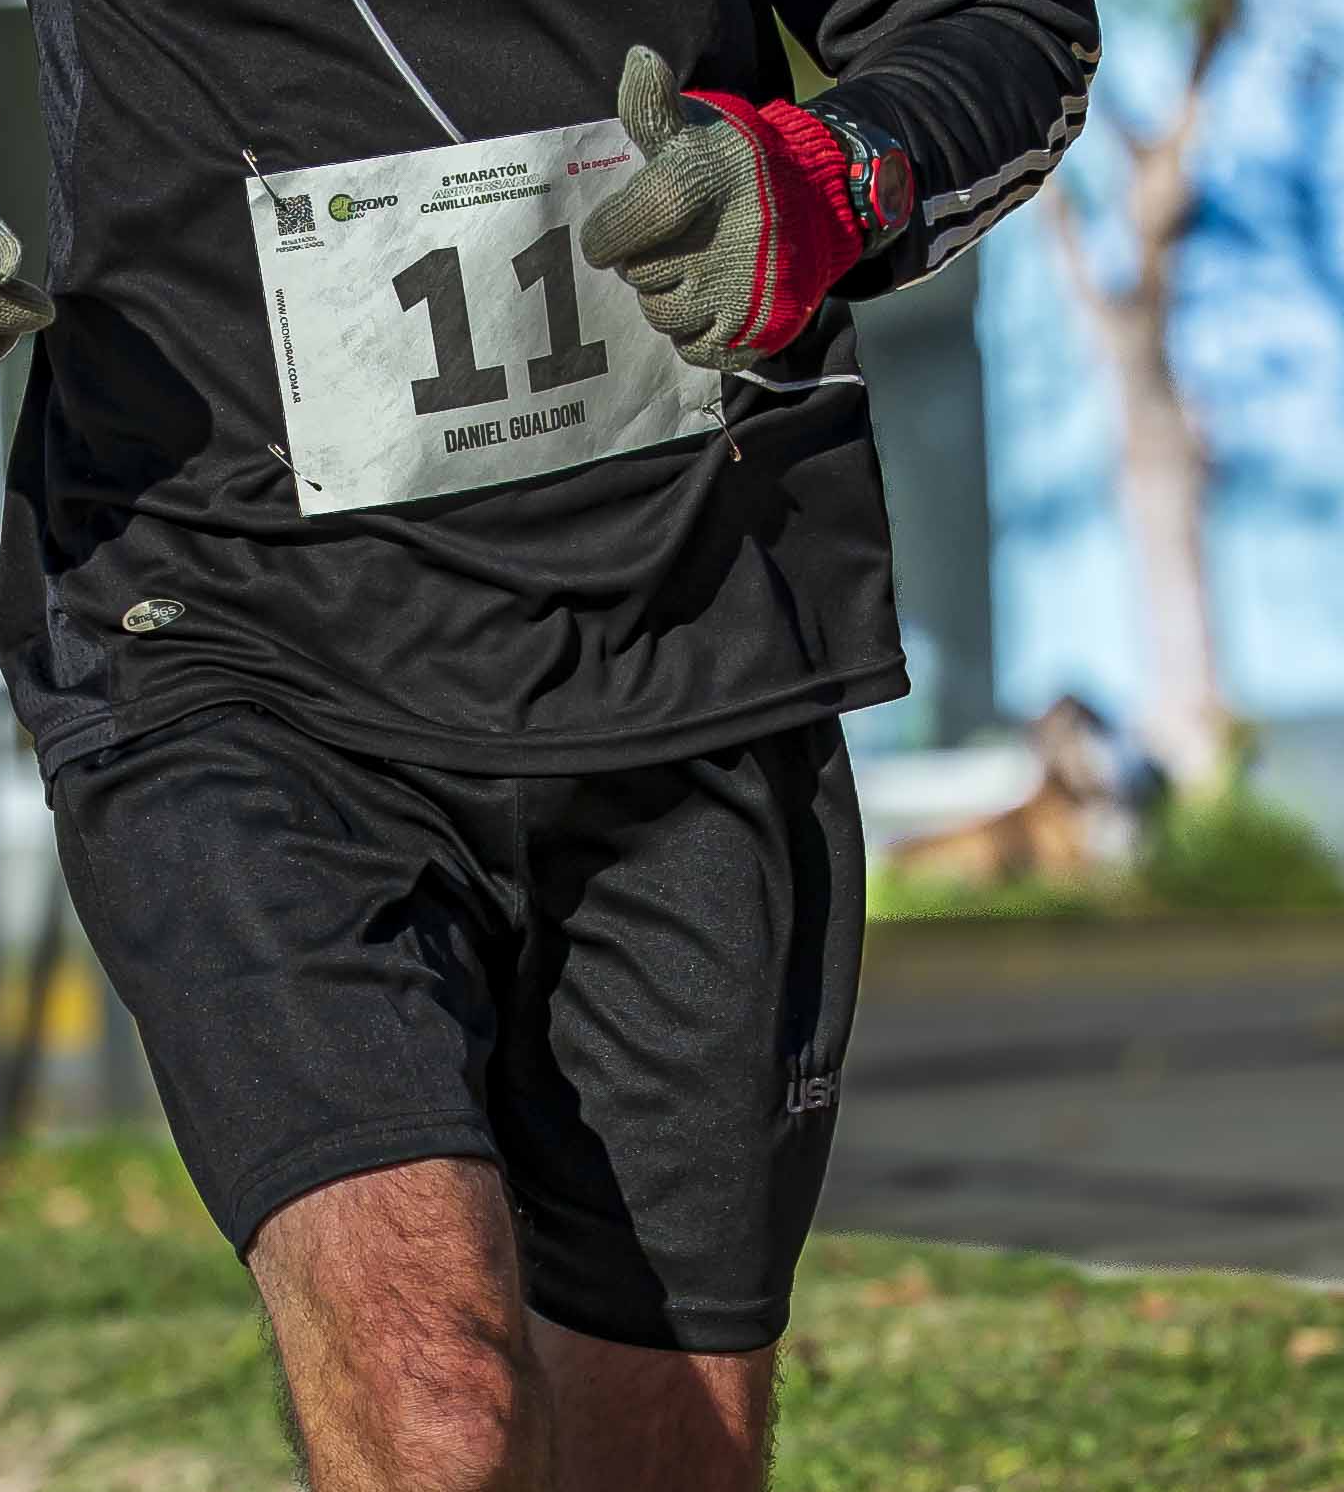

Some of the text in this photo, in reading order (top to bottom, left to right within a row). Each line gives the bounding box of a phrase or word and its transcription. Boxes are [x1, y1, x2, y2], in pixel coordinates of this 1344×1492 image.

[347, 194, 399, 212] CRONO
[275, 288, 302, 404] WWW.CRONORAV.COM.AR
[391, 224, 609, 417] 11
[443, 400, 586, 454] DANIEL GUALDONI
